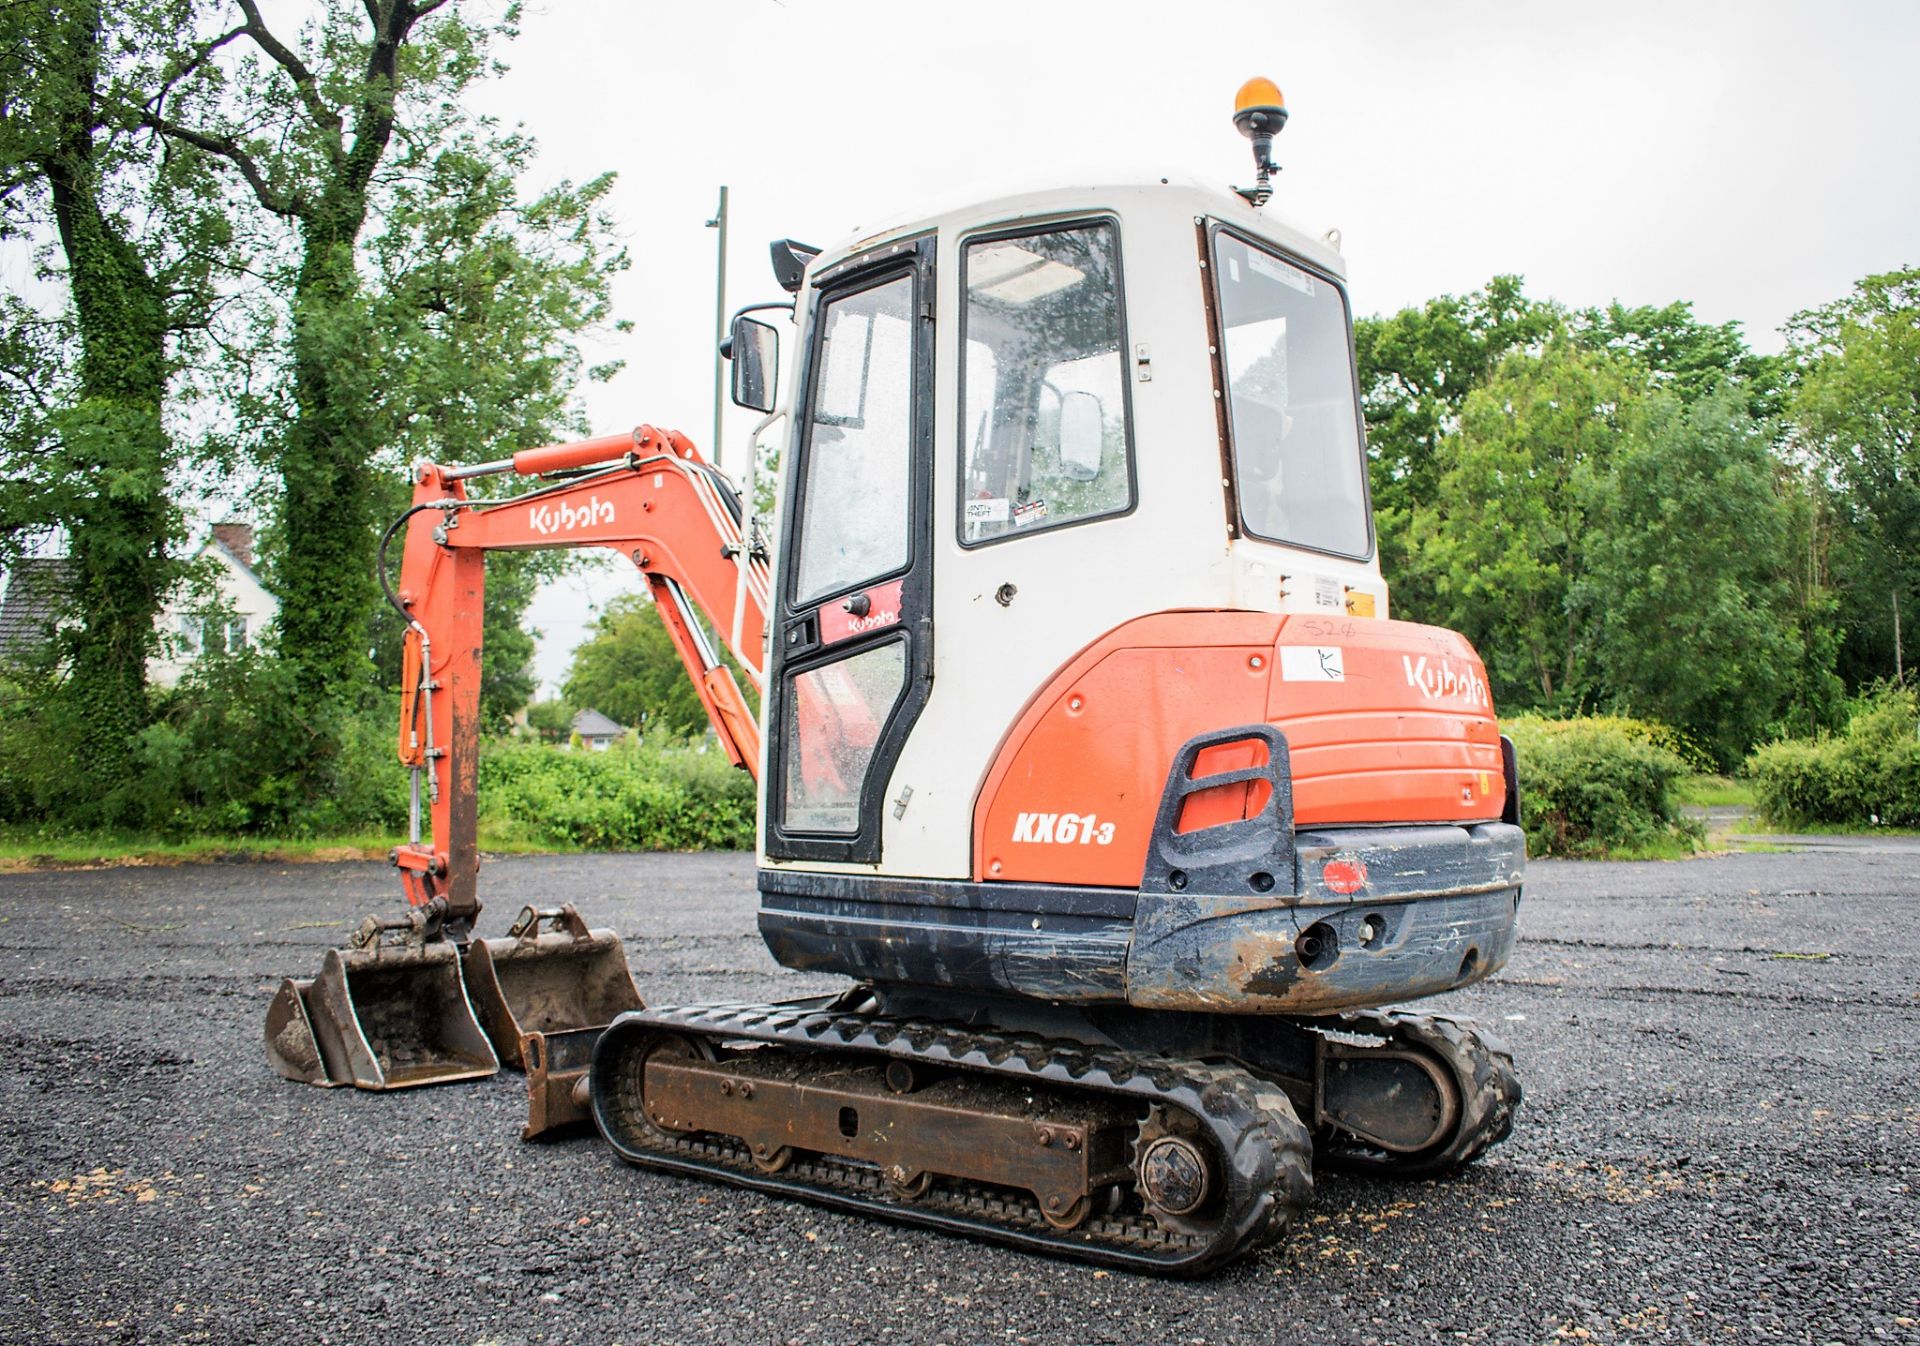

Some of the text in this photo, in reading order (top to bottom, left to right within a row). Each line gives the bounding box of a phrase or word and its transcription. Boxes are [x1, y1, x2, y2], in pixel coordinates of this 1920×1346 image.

[529, 495, 615, 535] Kubota
[848, 610, 894, 632] Kubota
[1402, 655, 1489, 707] Kubota
[1011, 812, 1116, 845] KX61-3
